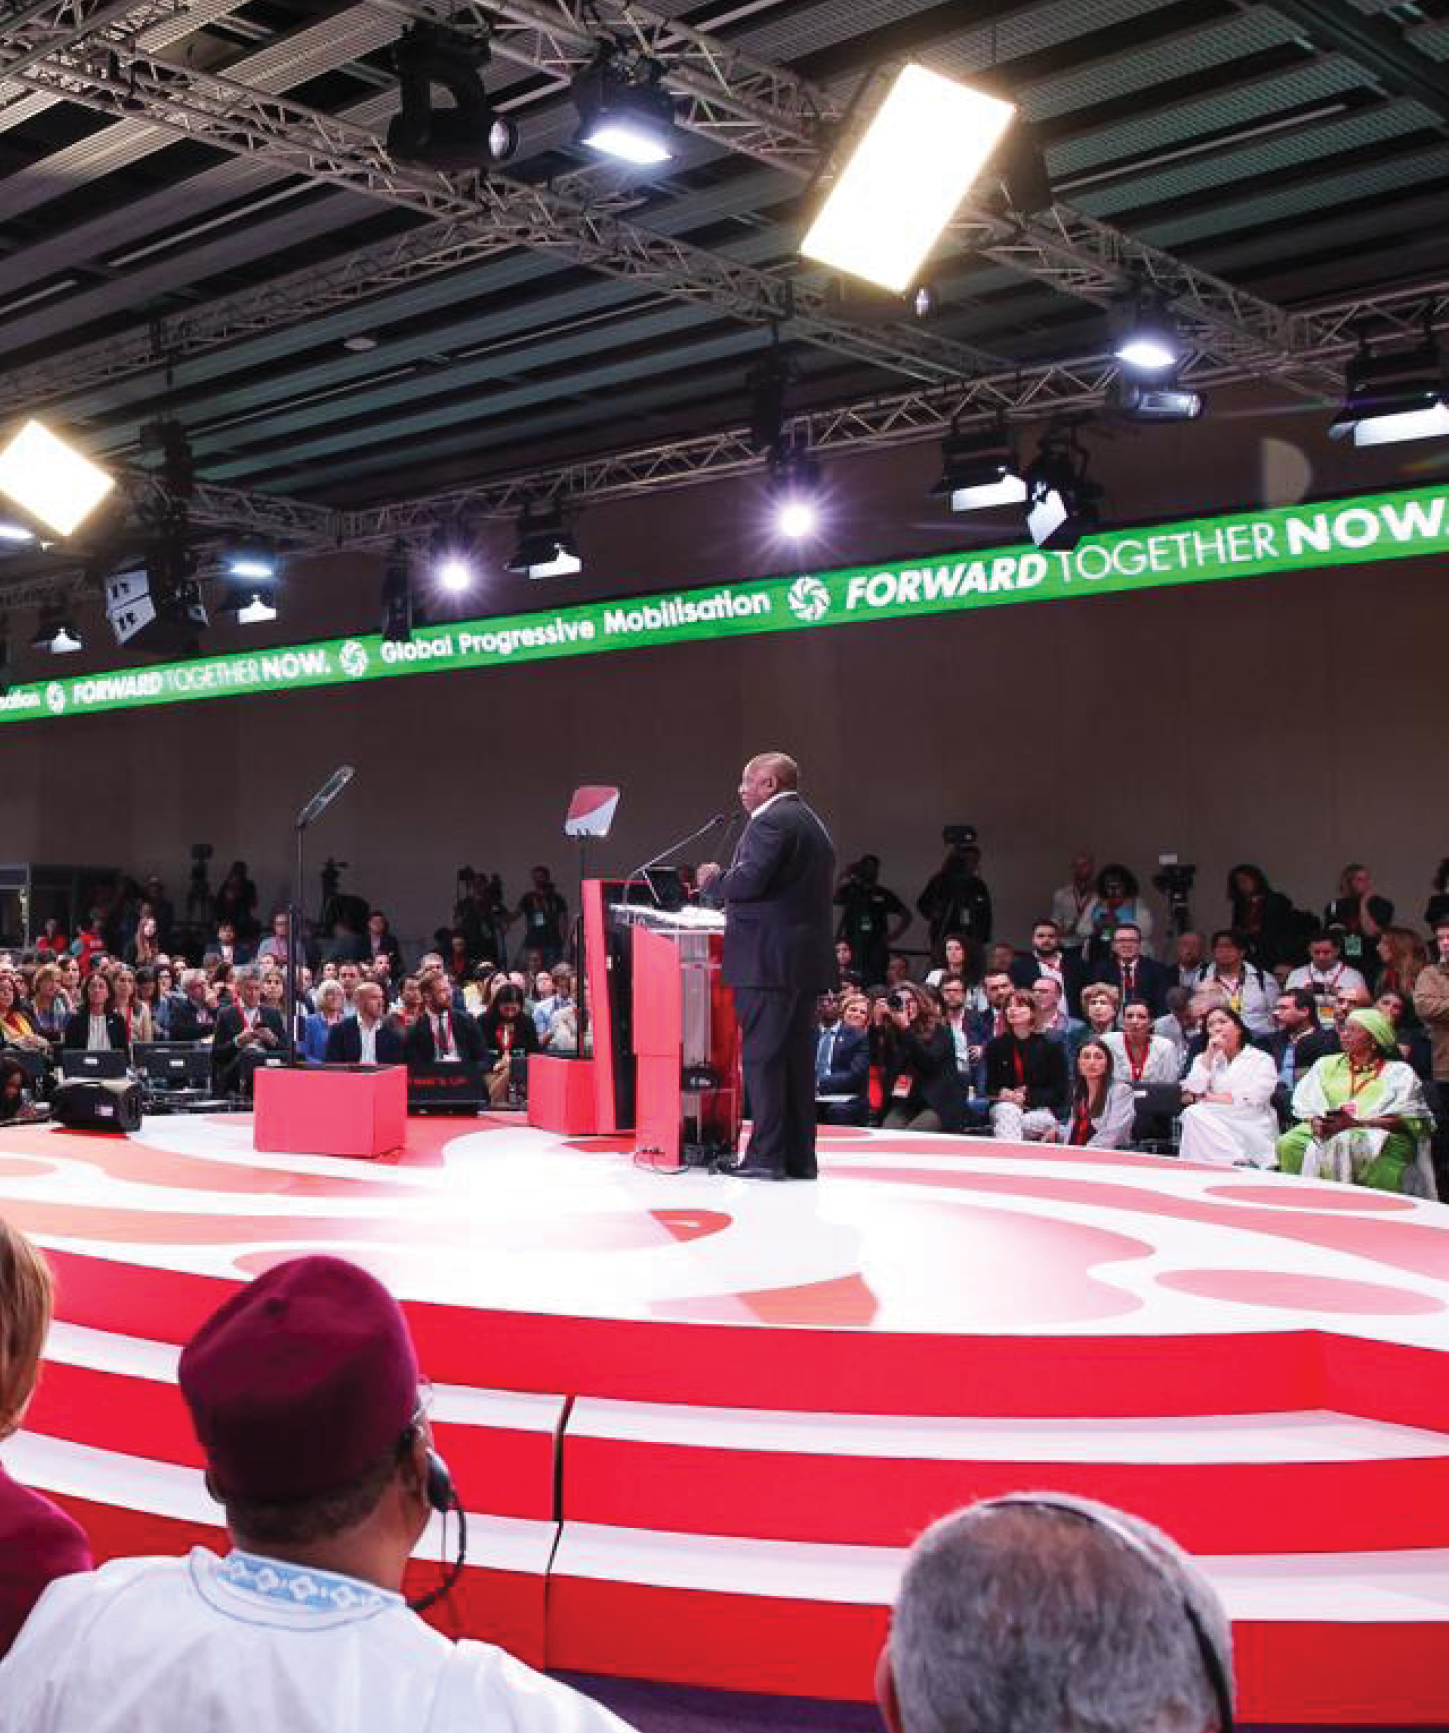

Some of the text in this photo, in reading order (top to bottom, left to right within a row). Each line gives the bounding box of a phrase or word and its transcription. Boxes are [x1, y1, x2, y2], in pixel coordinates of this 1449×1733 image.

[72, 672, 163, 704] FORWARD
[162, 655, 259, 692] TOGETHER
[261, 649, 332, 681] NOW.
[380, 635, 453, 664] Global
[460, 617, 595, 655] Progressive
[603, 590, 772, 634] Mobilisation
[846, 553, 1048, 610] FORWARD
[1050, 522, 1279, 583] TOGETHER
